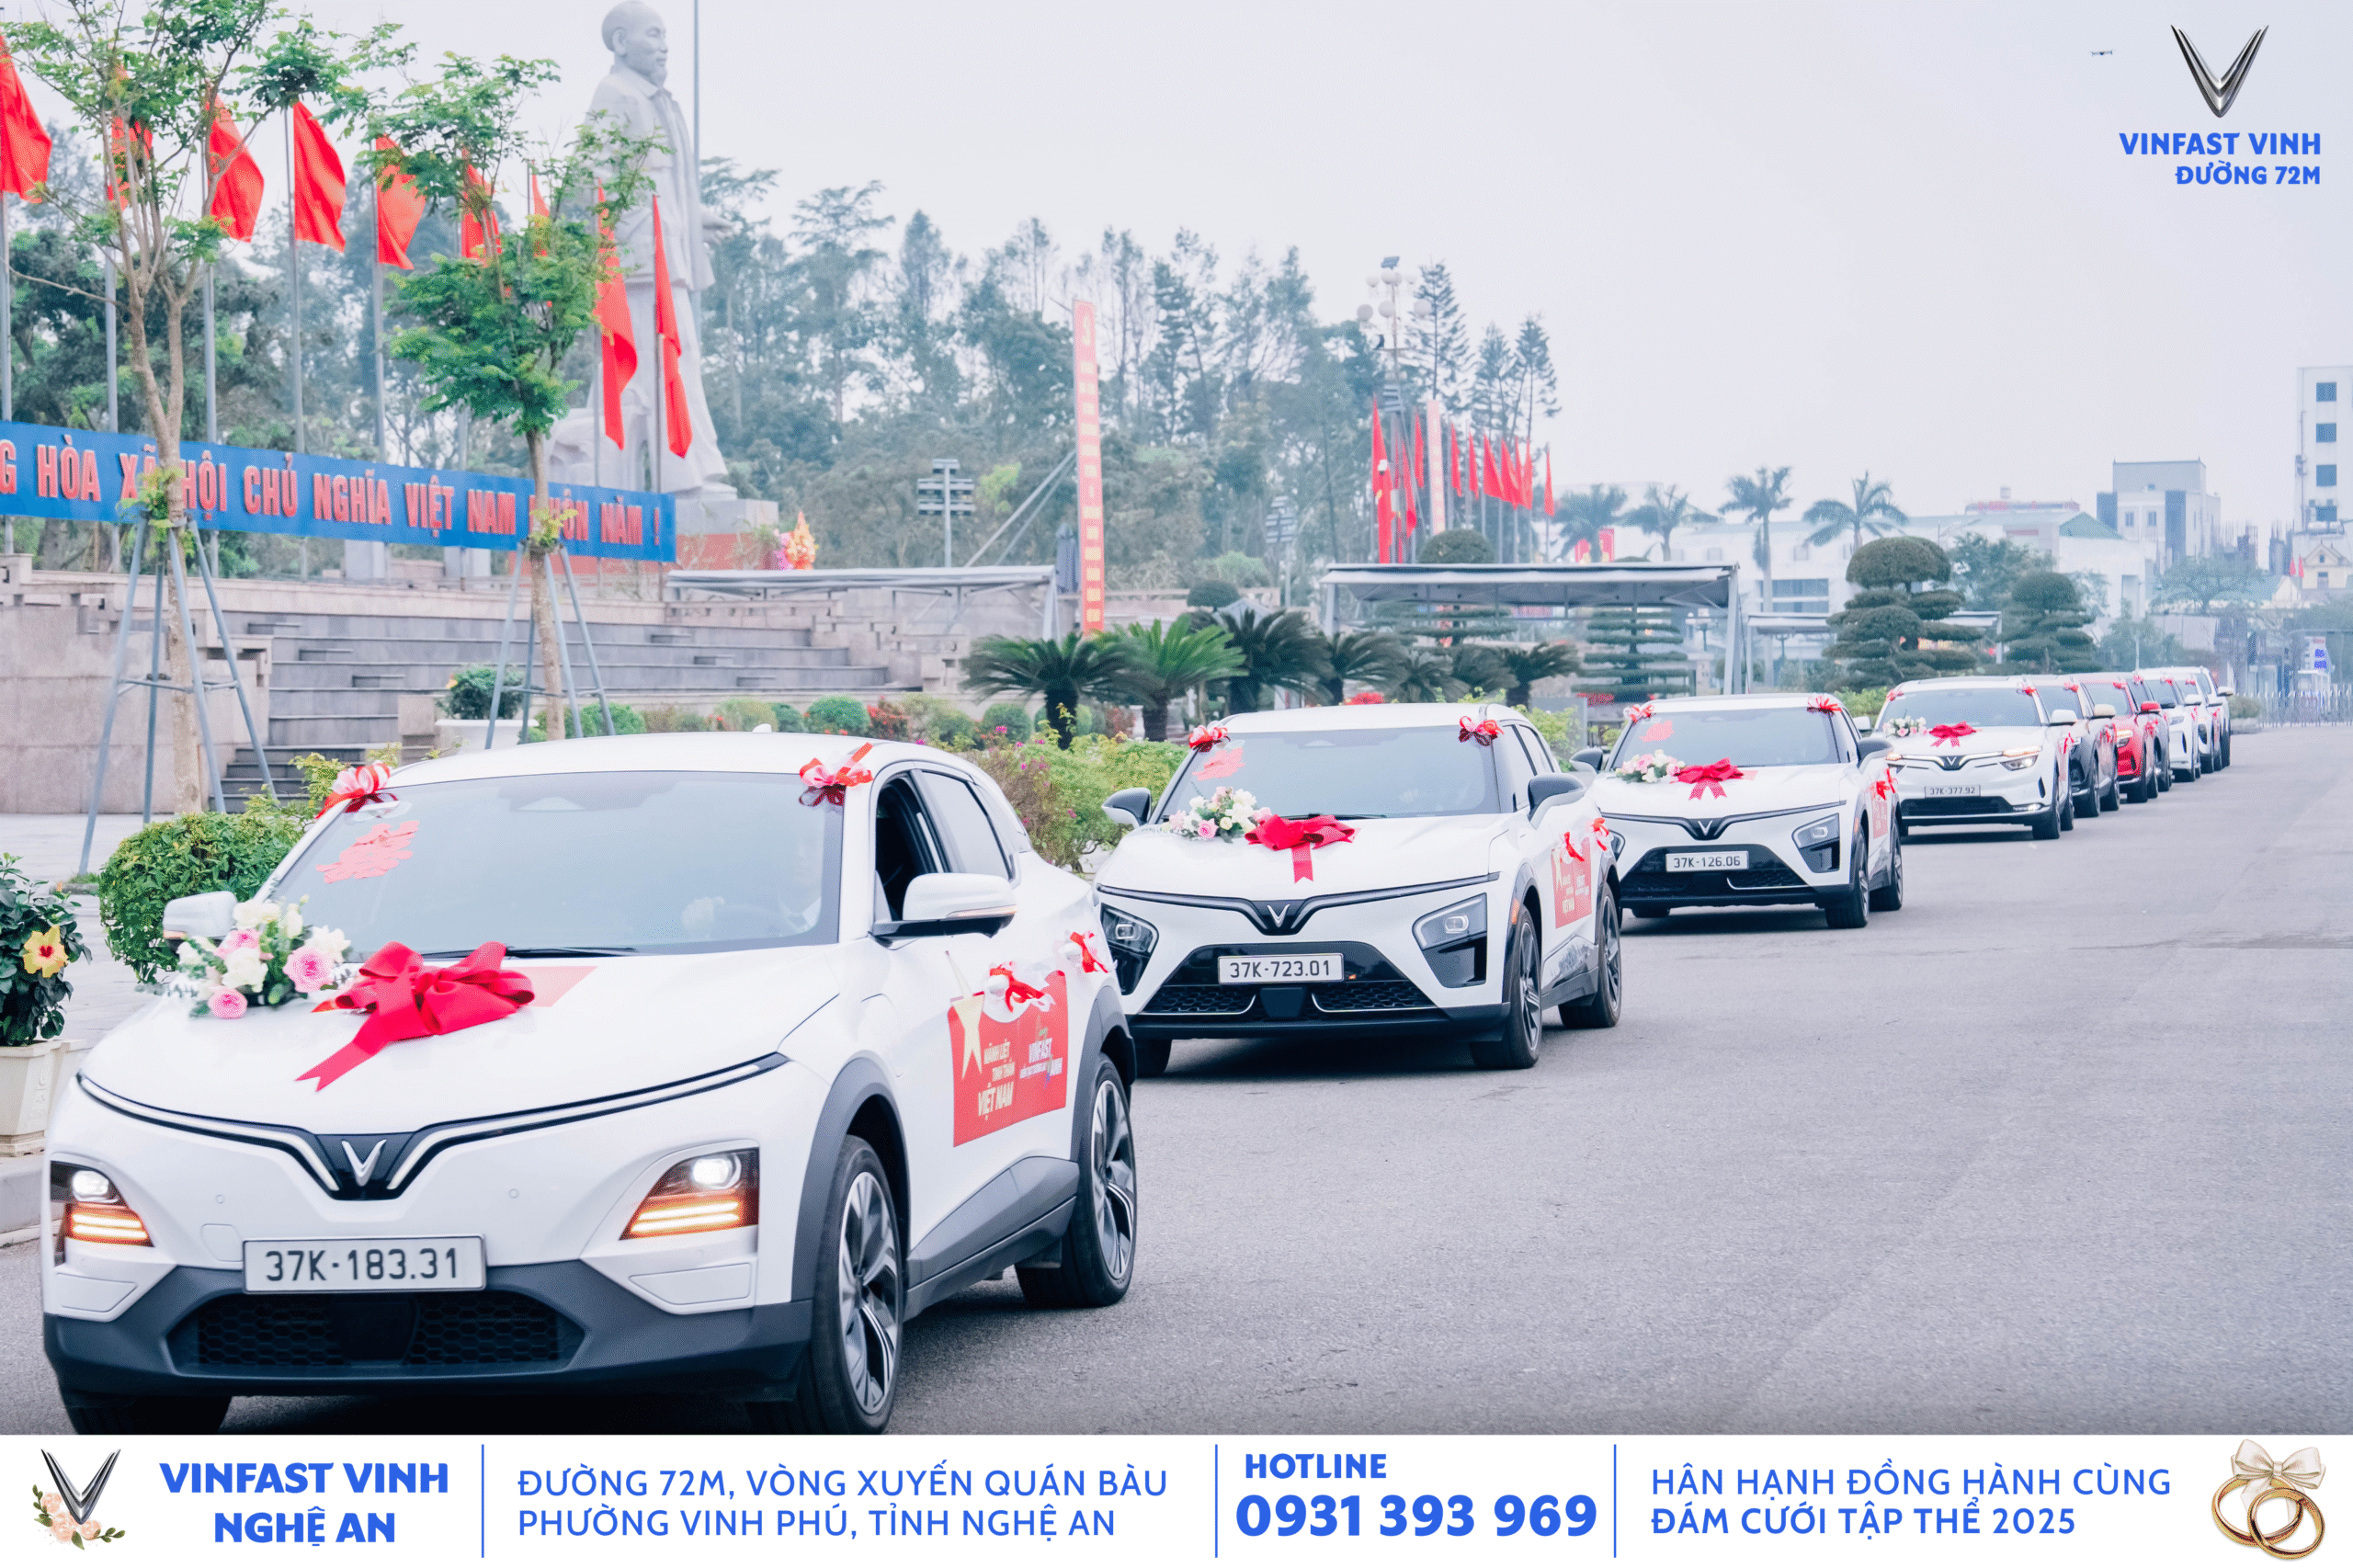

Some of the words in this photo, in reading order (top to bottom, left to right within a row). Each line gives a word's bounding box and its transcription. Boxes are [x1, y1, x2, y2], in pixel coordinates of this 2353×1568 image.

[35, 434, 101, 502] HÒA
[179, 449, 227, 520] HỘI
[243, 452, 298, 517] CHỦ
[313, 469, 392, 525] NGHĨA
[404, 474, 454, 538] VIỆT
[467, 489, 517, 535] NAM
[600, 494, 642, 545] NĂM
[1674, 856, 1741, 868] 37K-126.06
[1230, 960, 1329, 978] 37K-723.01
[266, 1248, 457, 1281] 37K-183.31
